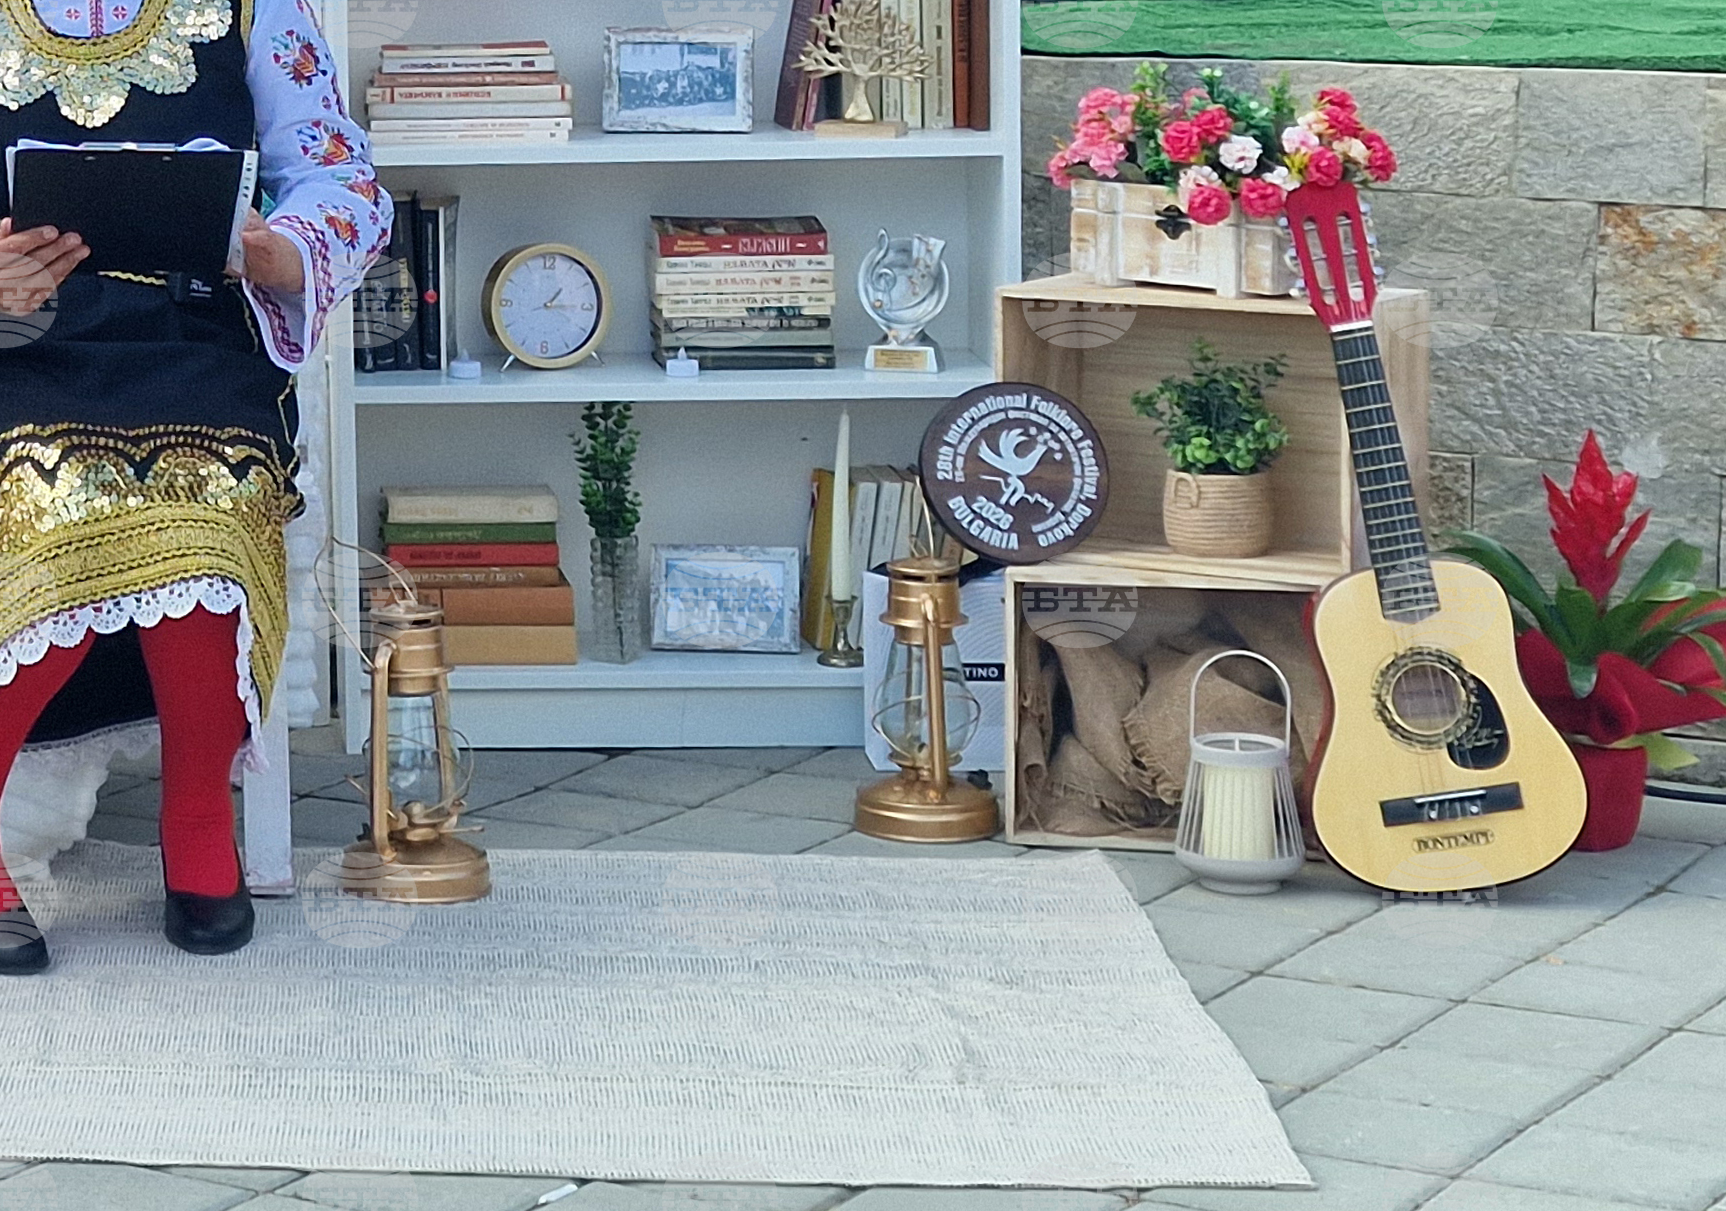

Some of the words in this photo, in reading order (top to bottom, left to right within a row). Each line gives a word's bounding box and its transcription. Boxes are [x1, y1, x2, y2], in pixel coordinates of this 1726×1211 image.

[541, 255, 556, 270] 12
[943, 393, 1027, 445] International
[1030, 395, 1084, 439] Folklore
[937, 445, 955, 480] 28th
[947, 495, 1019, 550] BULGARIA
[1038, 503, 1092, 547] Dorkovo
